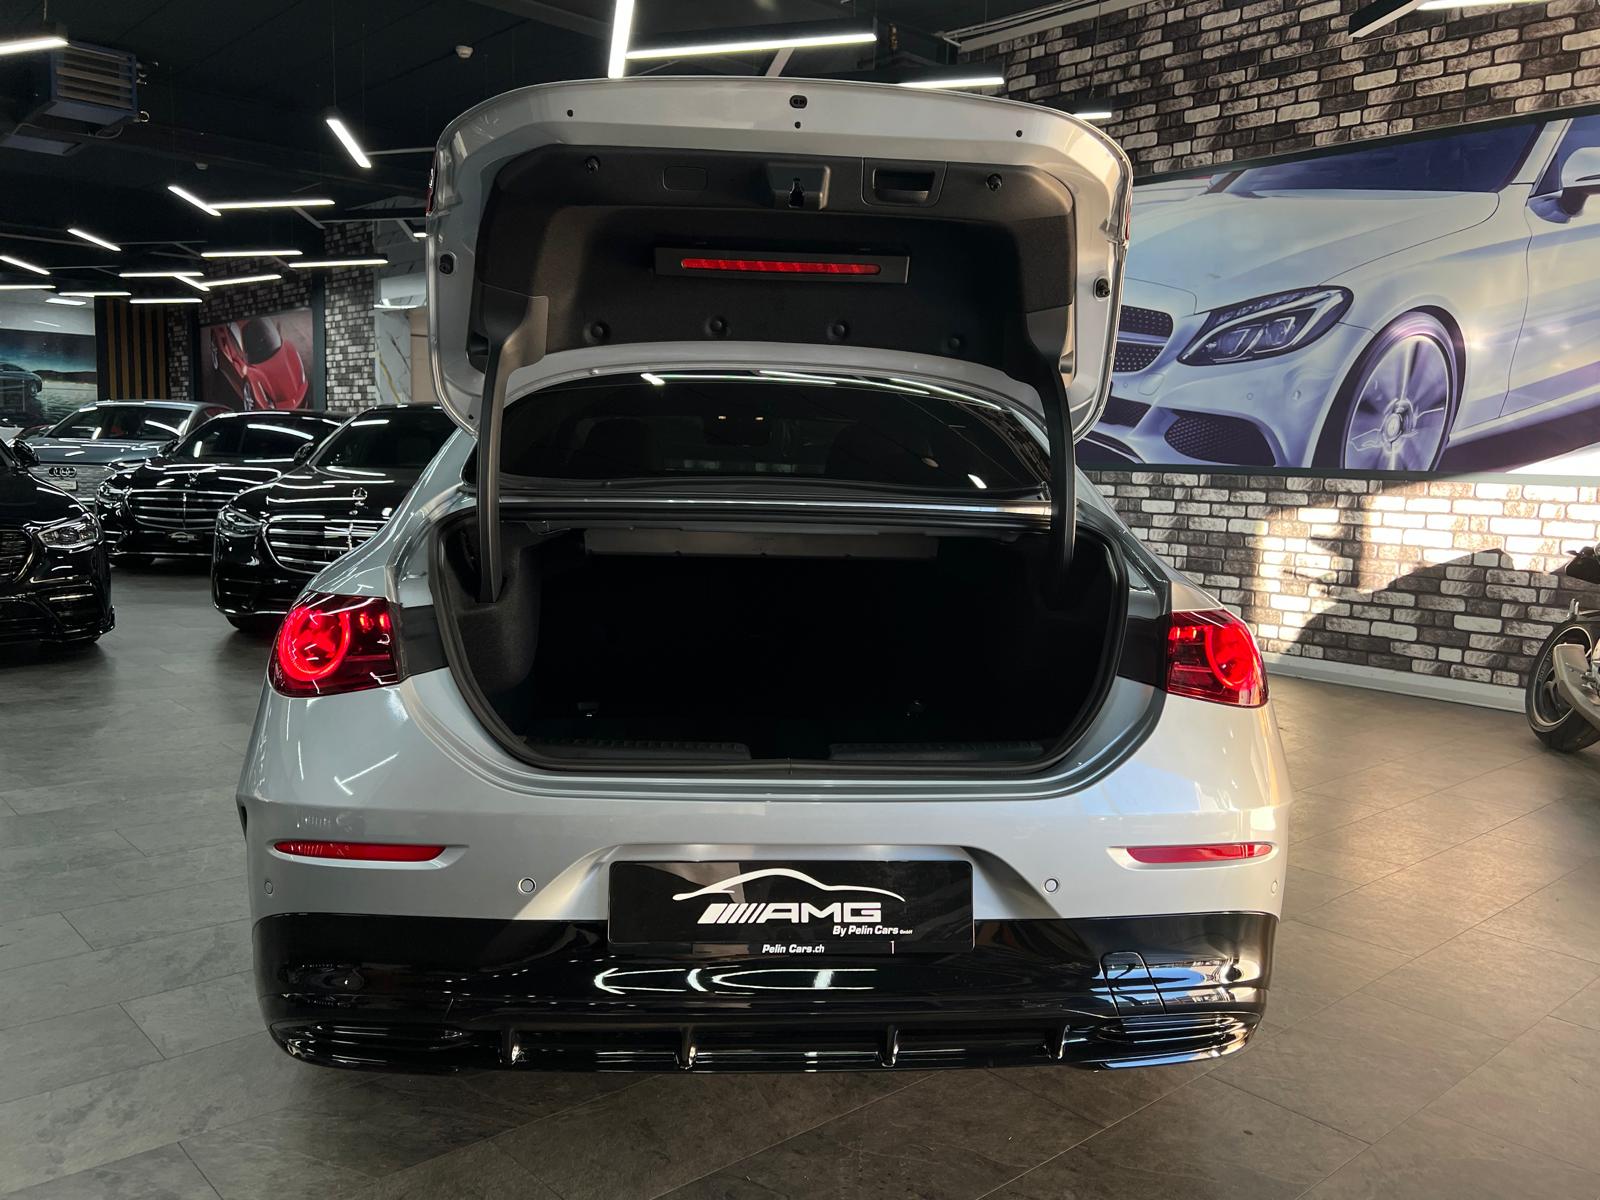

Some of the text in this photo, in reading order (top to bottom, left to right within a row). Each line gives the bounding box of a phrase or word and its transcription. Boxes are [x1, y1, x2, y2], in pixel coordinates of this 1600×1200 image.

[757, 902, 883, 924] AMG
[832, 925, 847, 938] By
[848, 925, 873, 935] Pelin
[874, 925, 899, 935] Cars
[761, 943, 825, 954] Pelin Cars.ch
